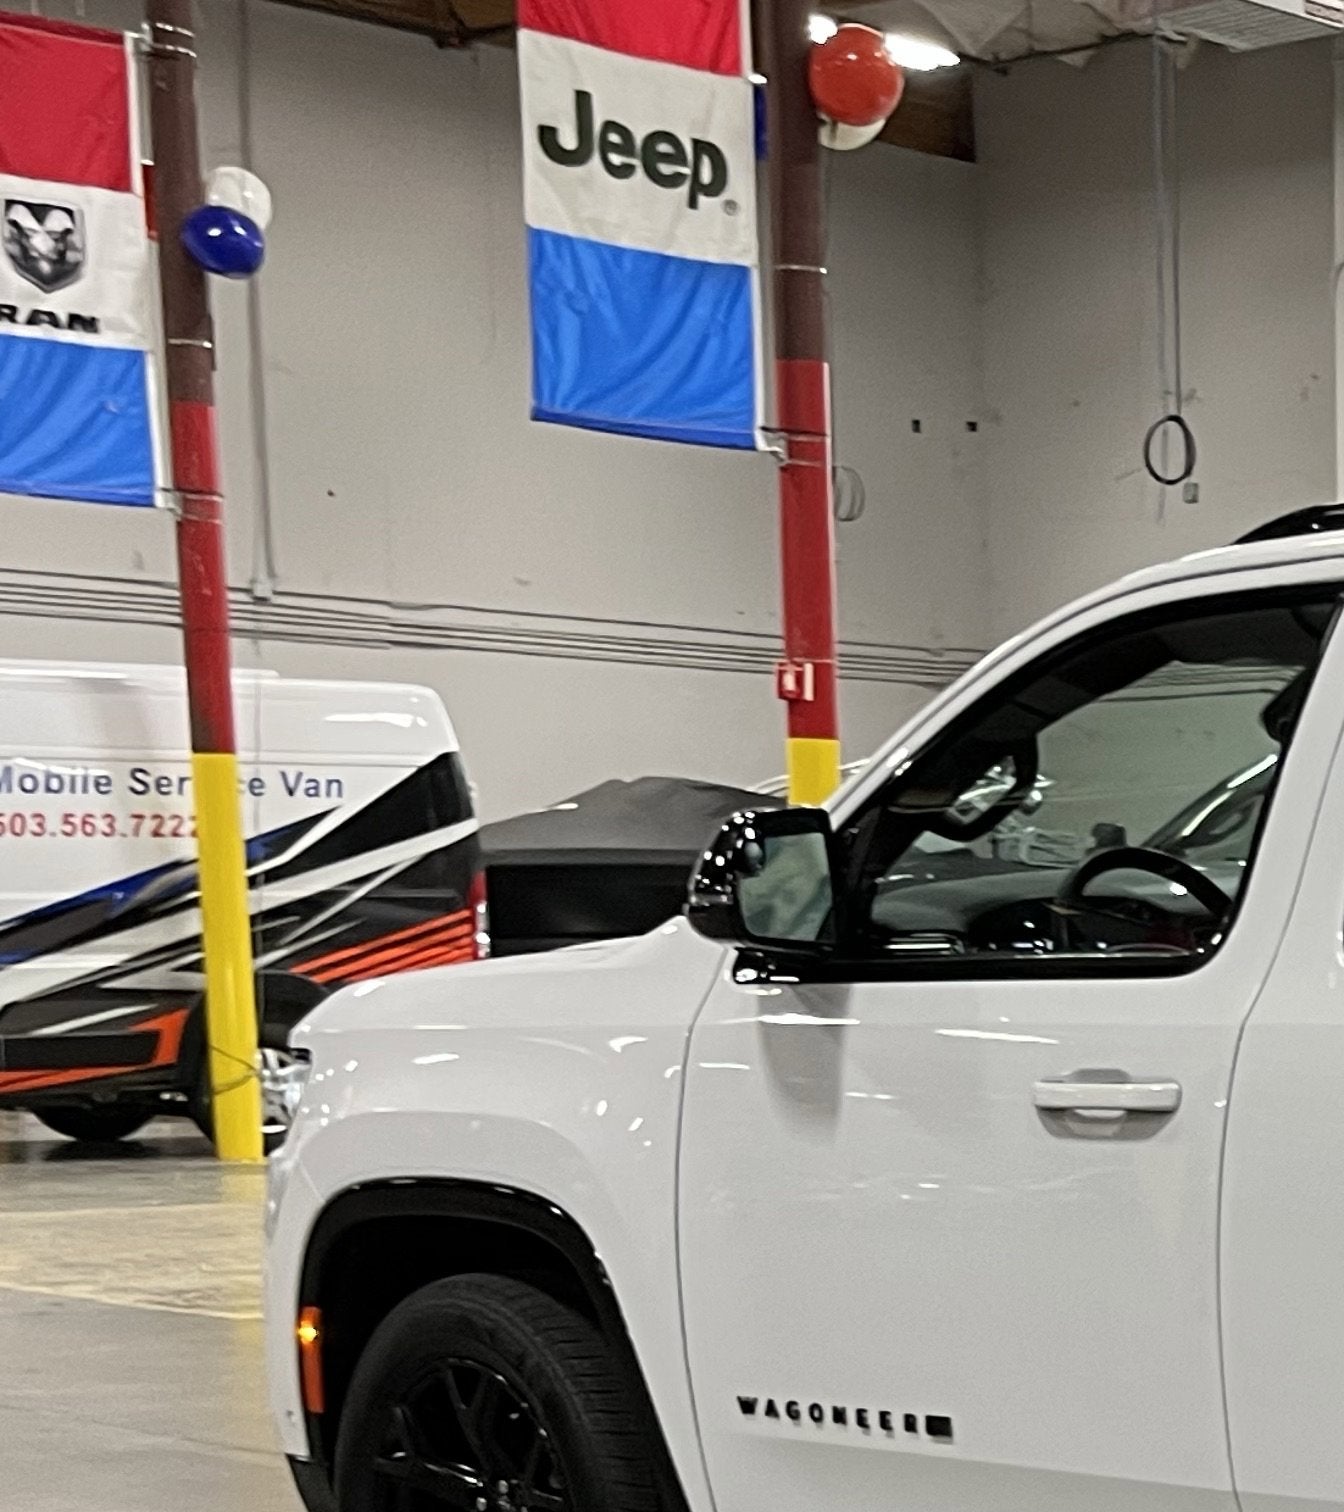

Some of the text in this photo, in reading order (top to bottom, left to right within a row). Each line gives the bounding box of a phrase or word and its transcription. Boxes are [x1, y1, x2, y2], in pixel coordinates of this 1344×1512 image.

[537, 88, 728, 211] Jeep
[128, 767, 266, 796] Sere
[280, 770, 344, 798] Van
[736, 1395, 918, 1434] WAGONEER
